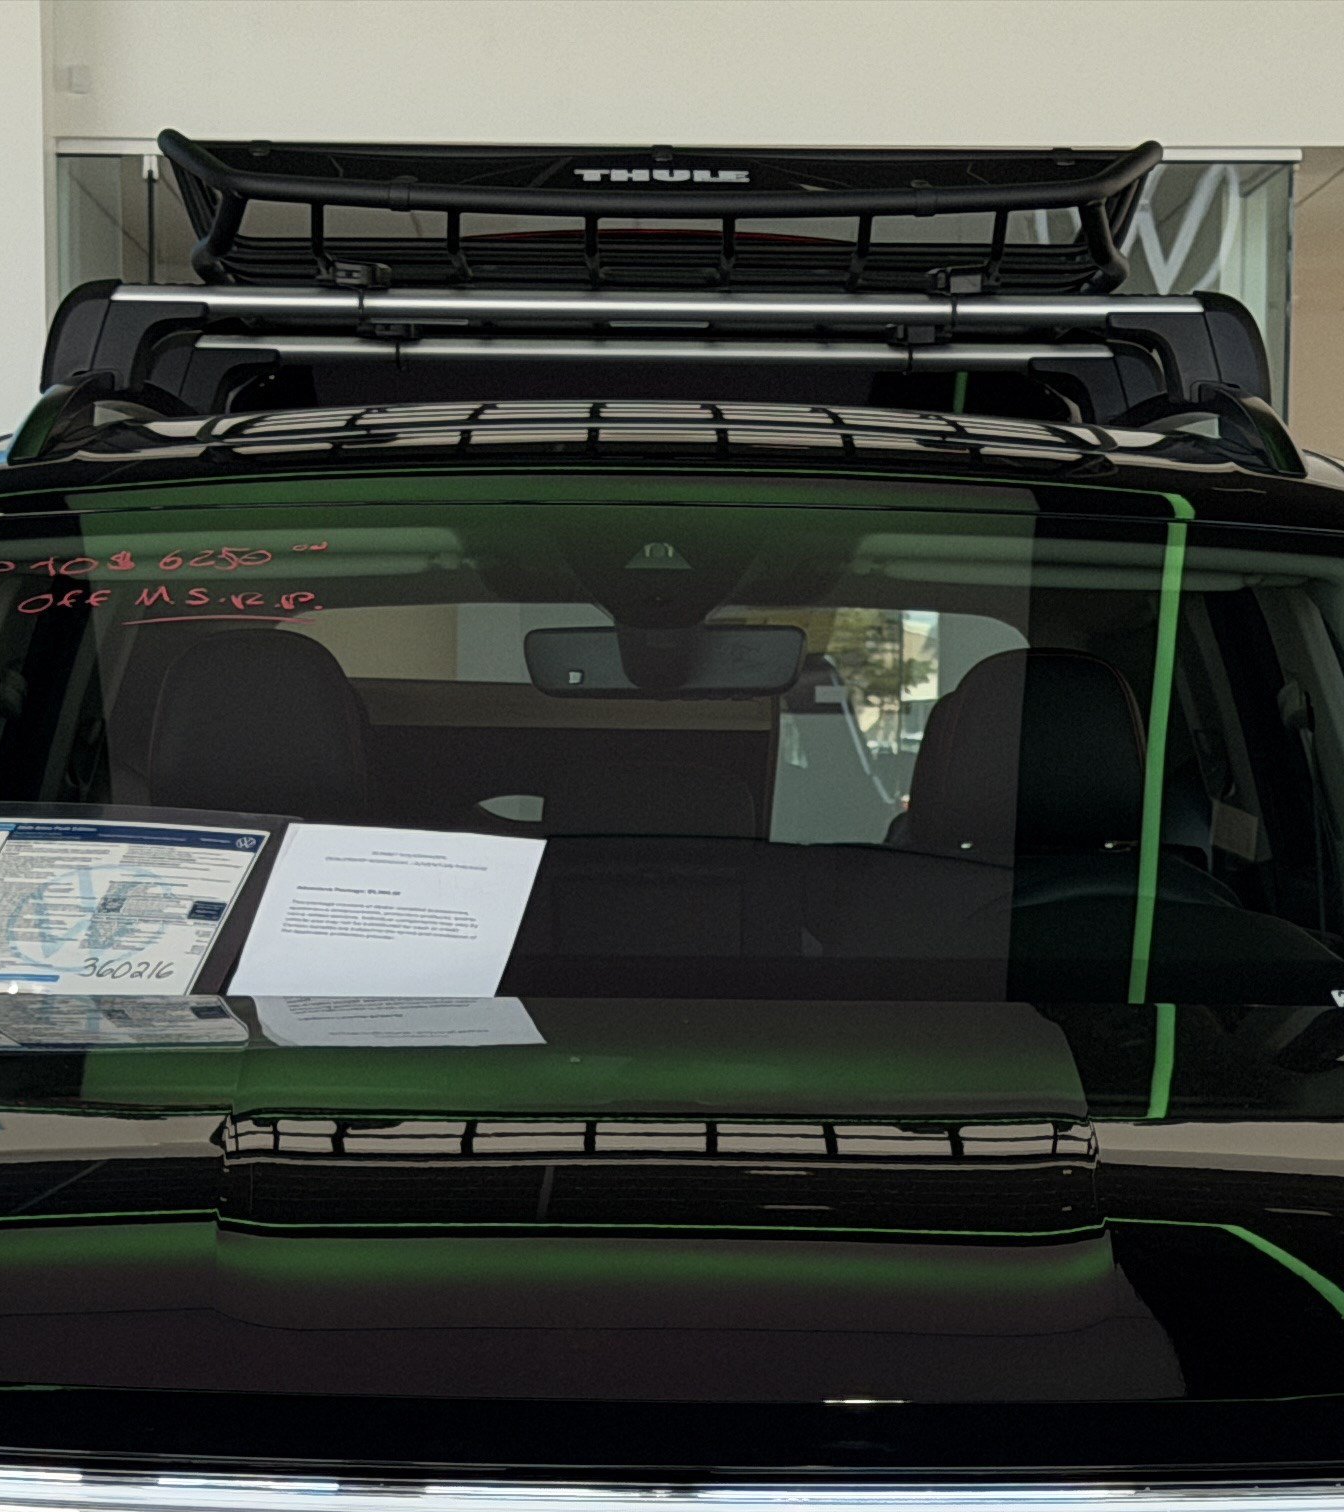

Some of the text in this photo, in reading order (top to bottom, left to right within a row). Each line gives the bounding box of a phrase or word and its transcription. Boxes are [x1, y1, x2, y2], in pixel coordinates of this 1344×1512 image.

[573, 168, 751, 183] THULE
[29, 556, 99, 577] TO
[17, 589, 113, 615] OFF
[78, 956, 176, 980] 360216
